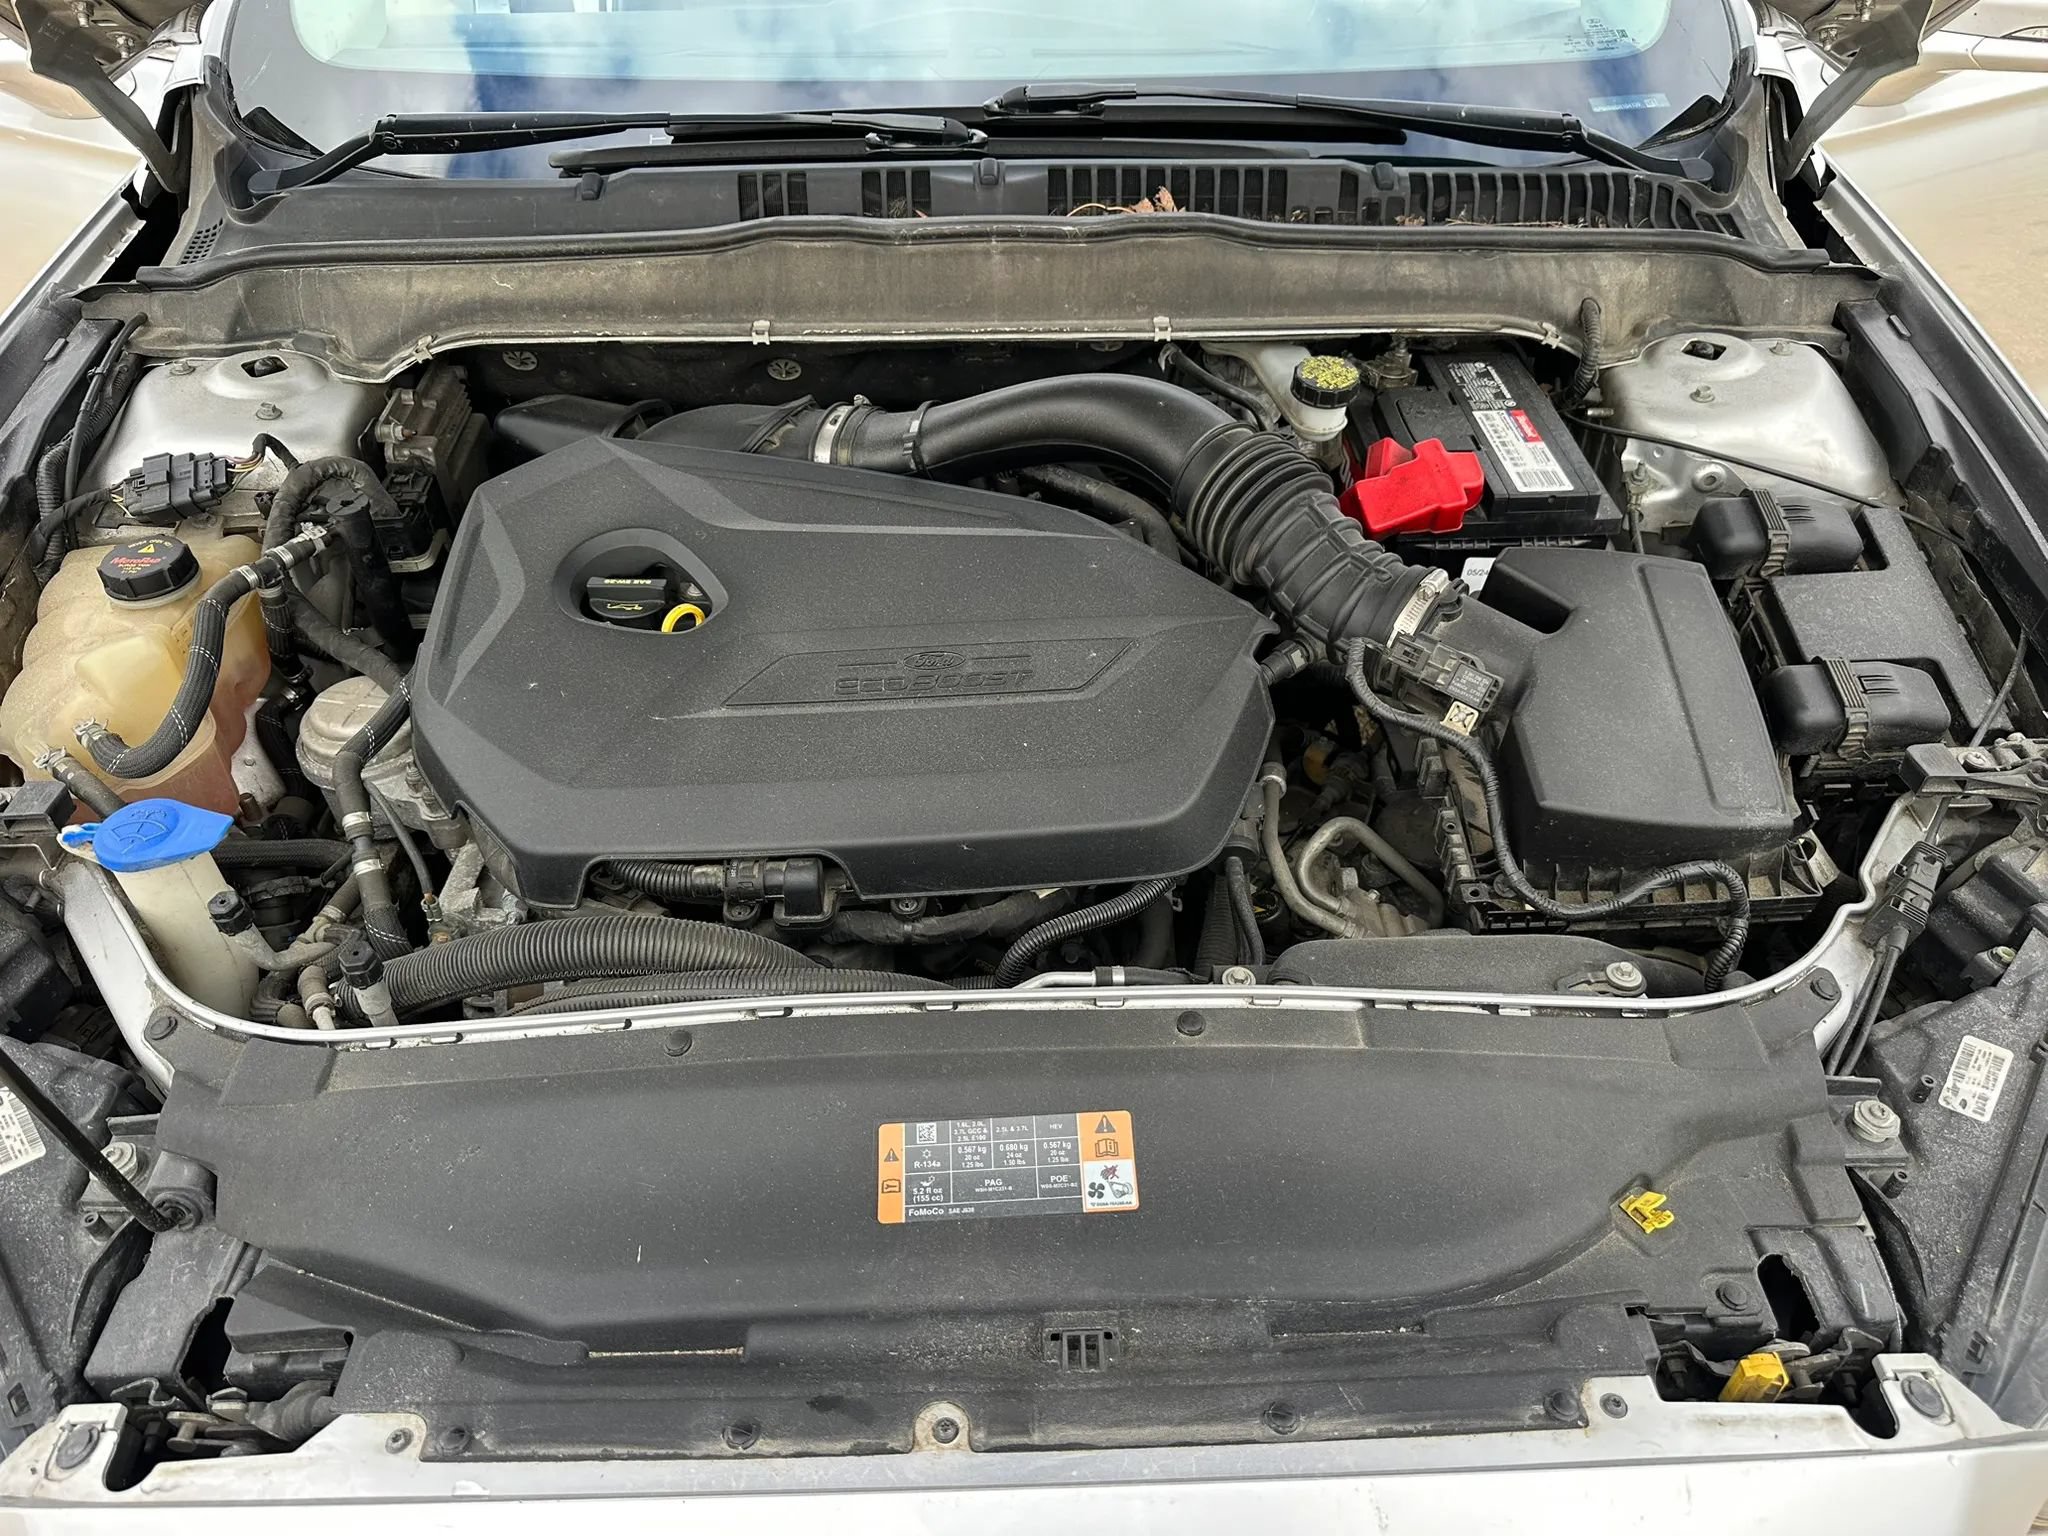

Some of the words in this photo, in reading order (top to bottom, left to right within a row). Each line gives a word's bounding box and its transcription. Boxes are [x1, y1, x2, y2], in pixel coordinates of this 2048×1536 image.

[957, 1146, 976, 1154] 0.567
[977, 1145, 987, 1154] kg
[999, 1143, 1018, 1151] 0.680
[1019, 1143, 1029, 1152] kg
[1062, 1141, 1072, 1150] kg
[913, 1160, 941, 1169] R-134a
[974, 1160, 984, 1168] lbs
[984, 1178, 1003, 1187] PAG
[912, 1187, 924, 1195] 5.2
[912, 1195, 930, 1204] (155
[930, 1194, 944, 1203] cc)
[908, 1207, 945, 1217] FoMoCo
